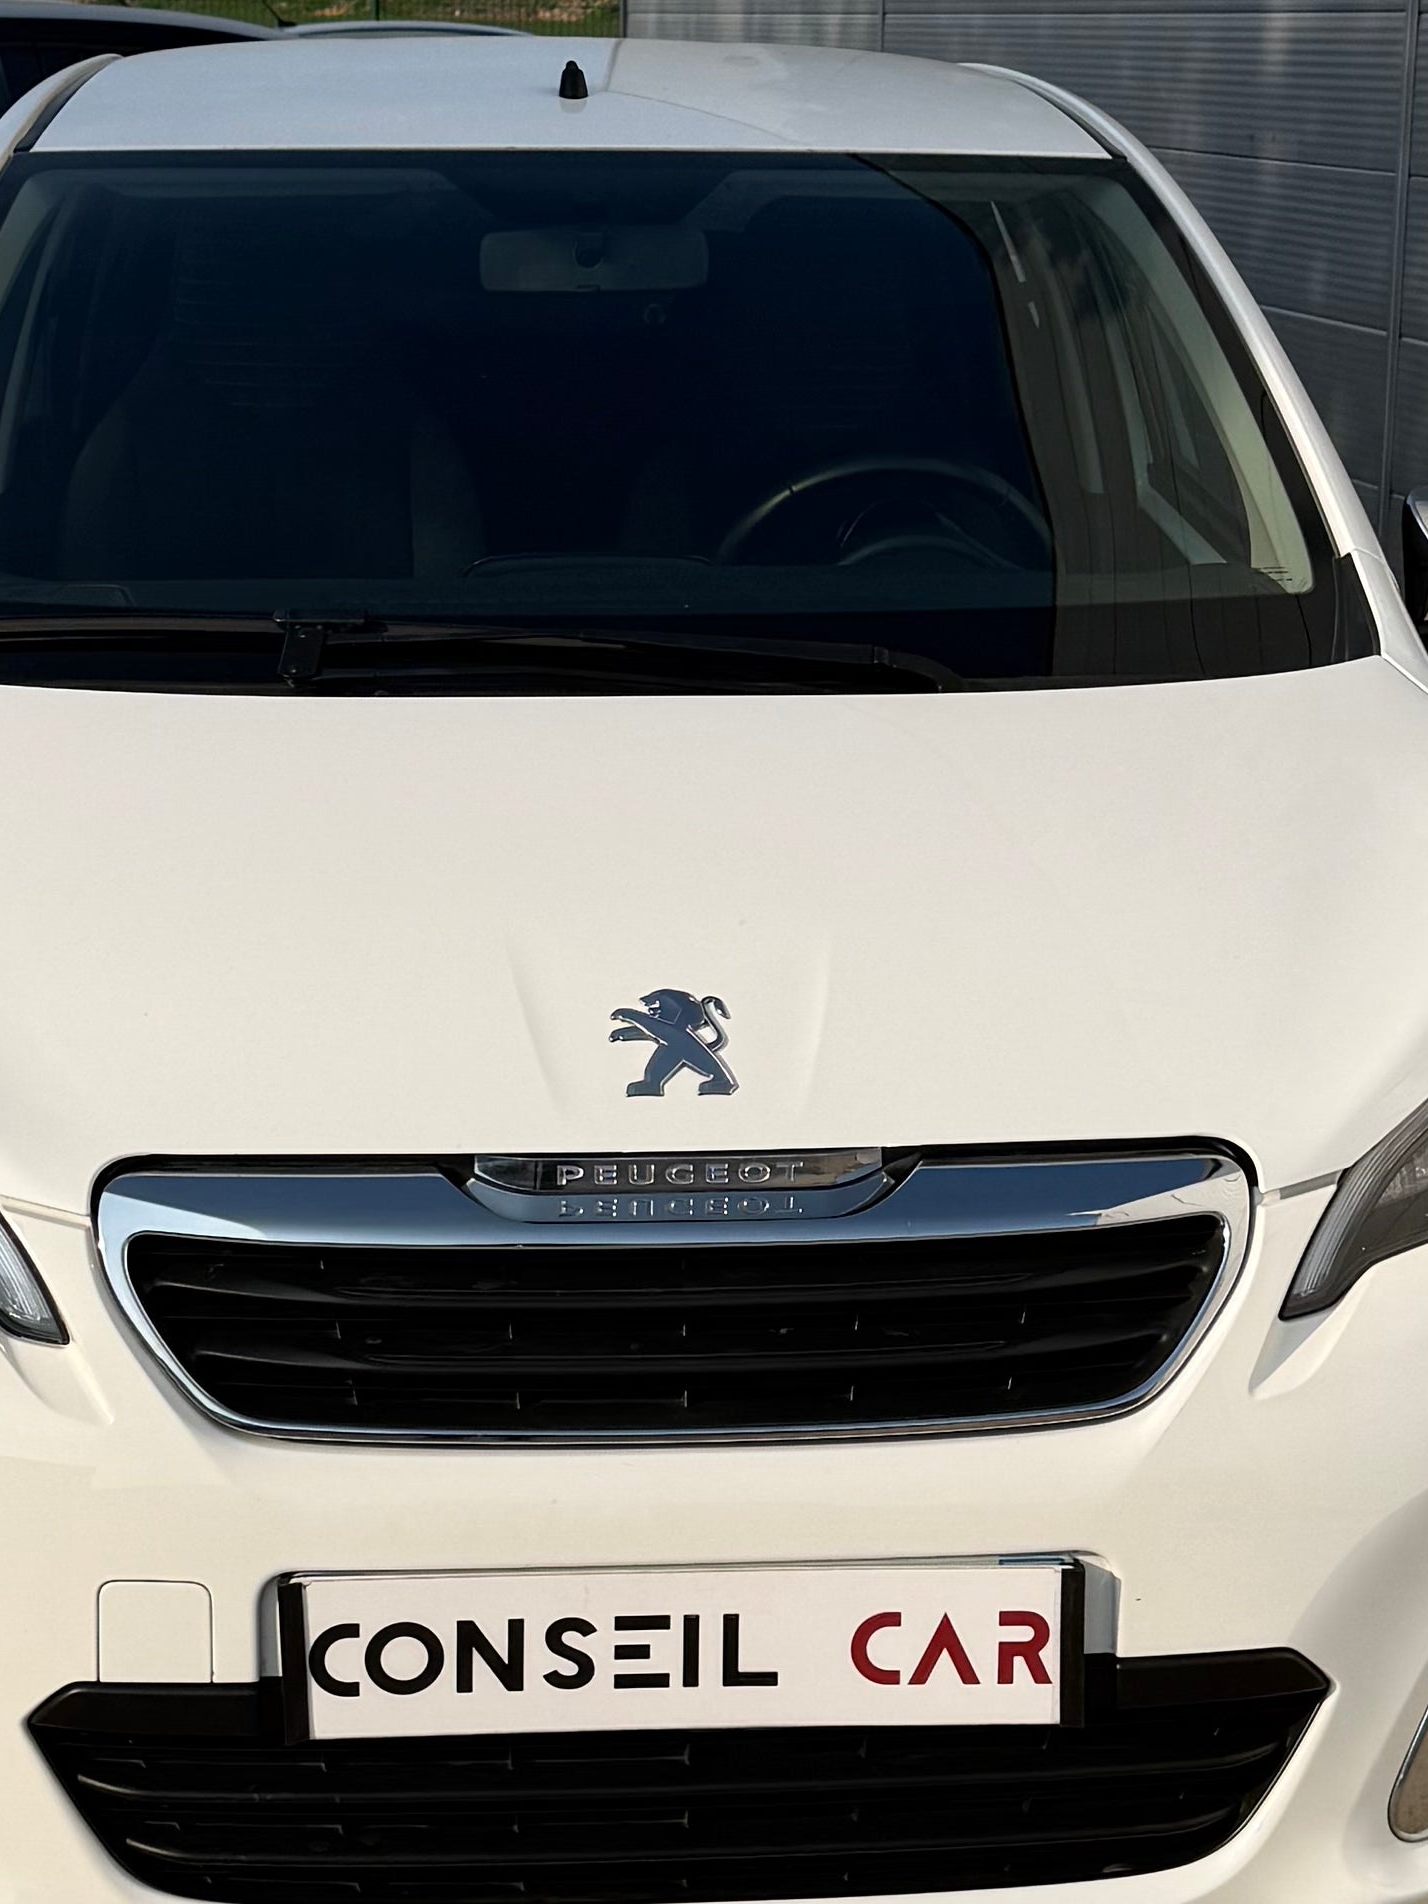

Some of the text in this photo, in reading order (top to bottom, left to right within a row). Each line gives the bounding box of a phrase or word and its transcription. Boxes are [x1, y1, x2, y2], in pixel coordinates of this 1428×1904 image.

[556, 1161, 804, 1186] PEUGEOT
[308, 1611, 1054, 1697] CONSEIL CAR
